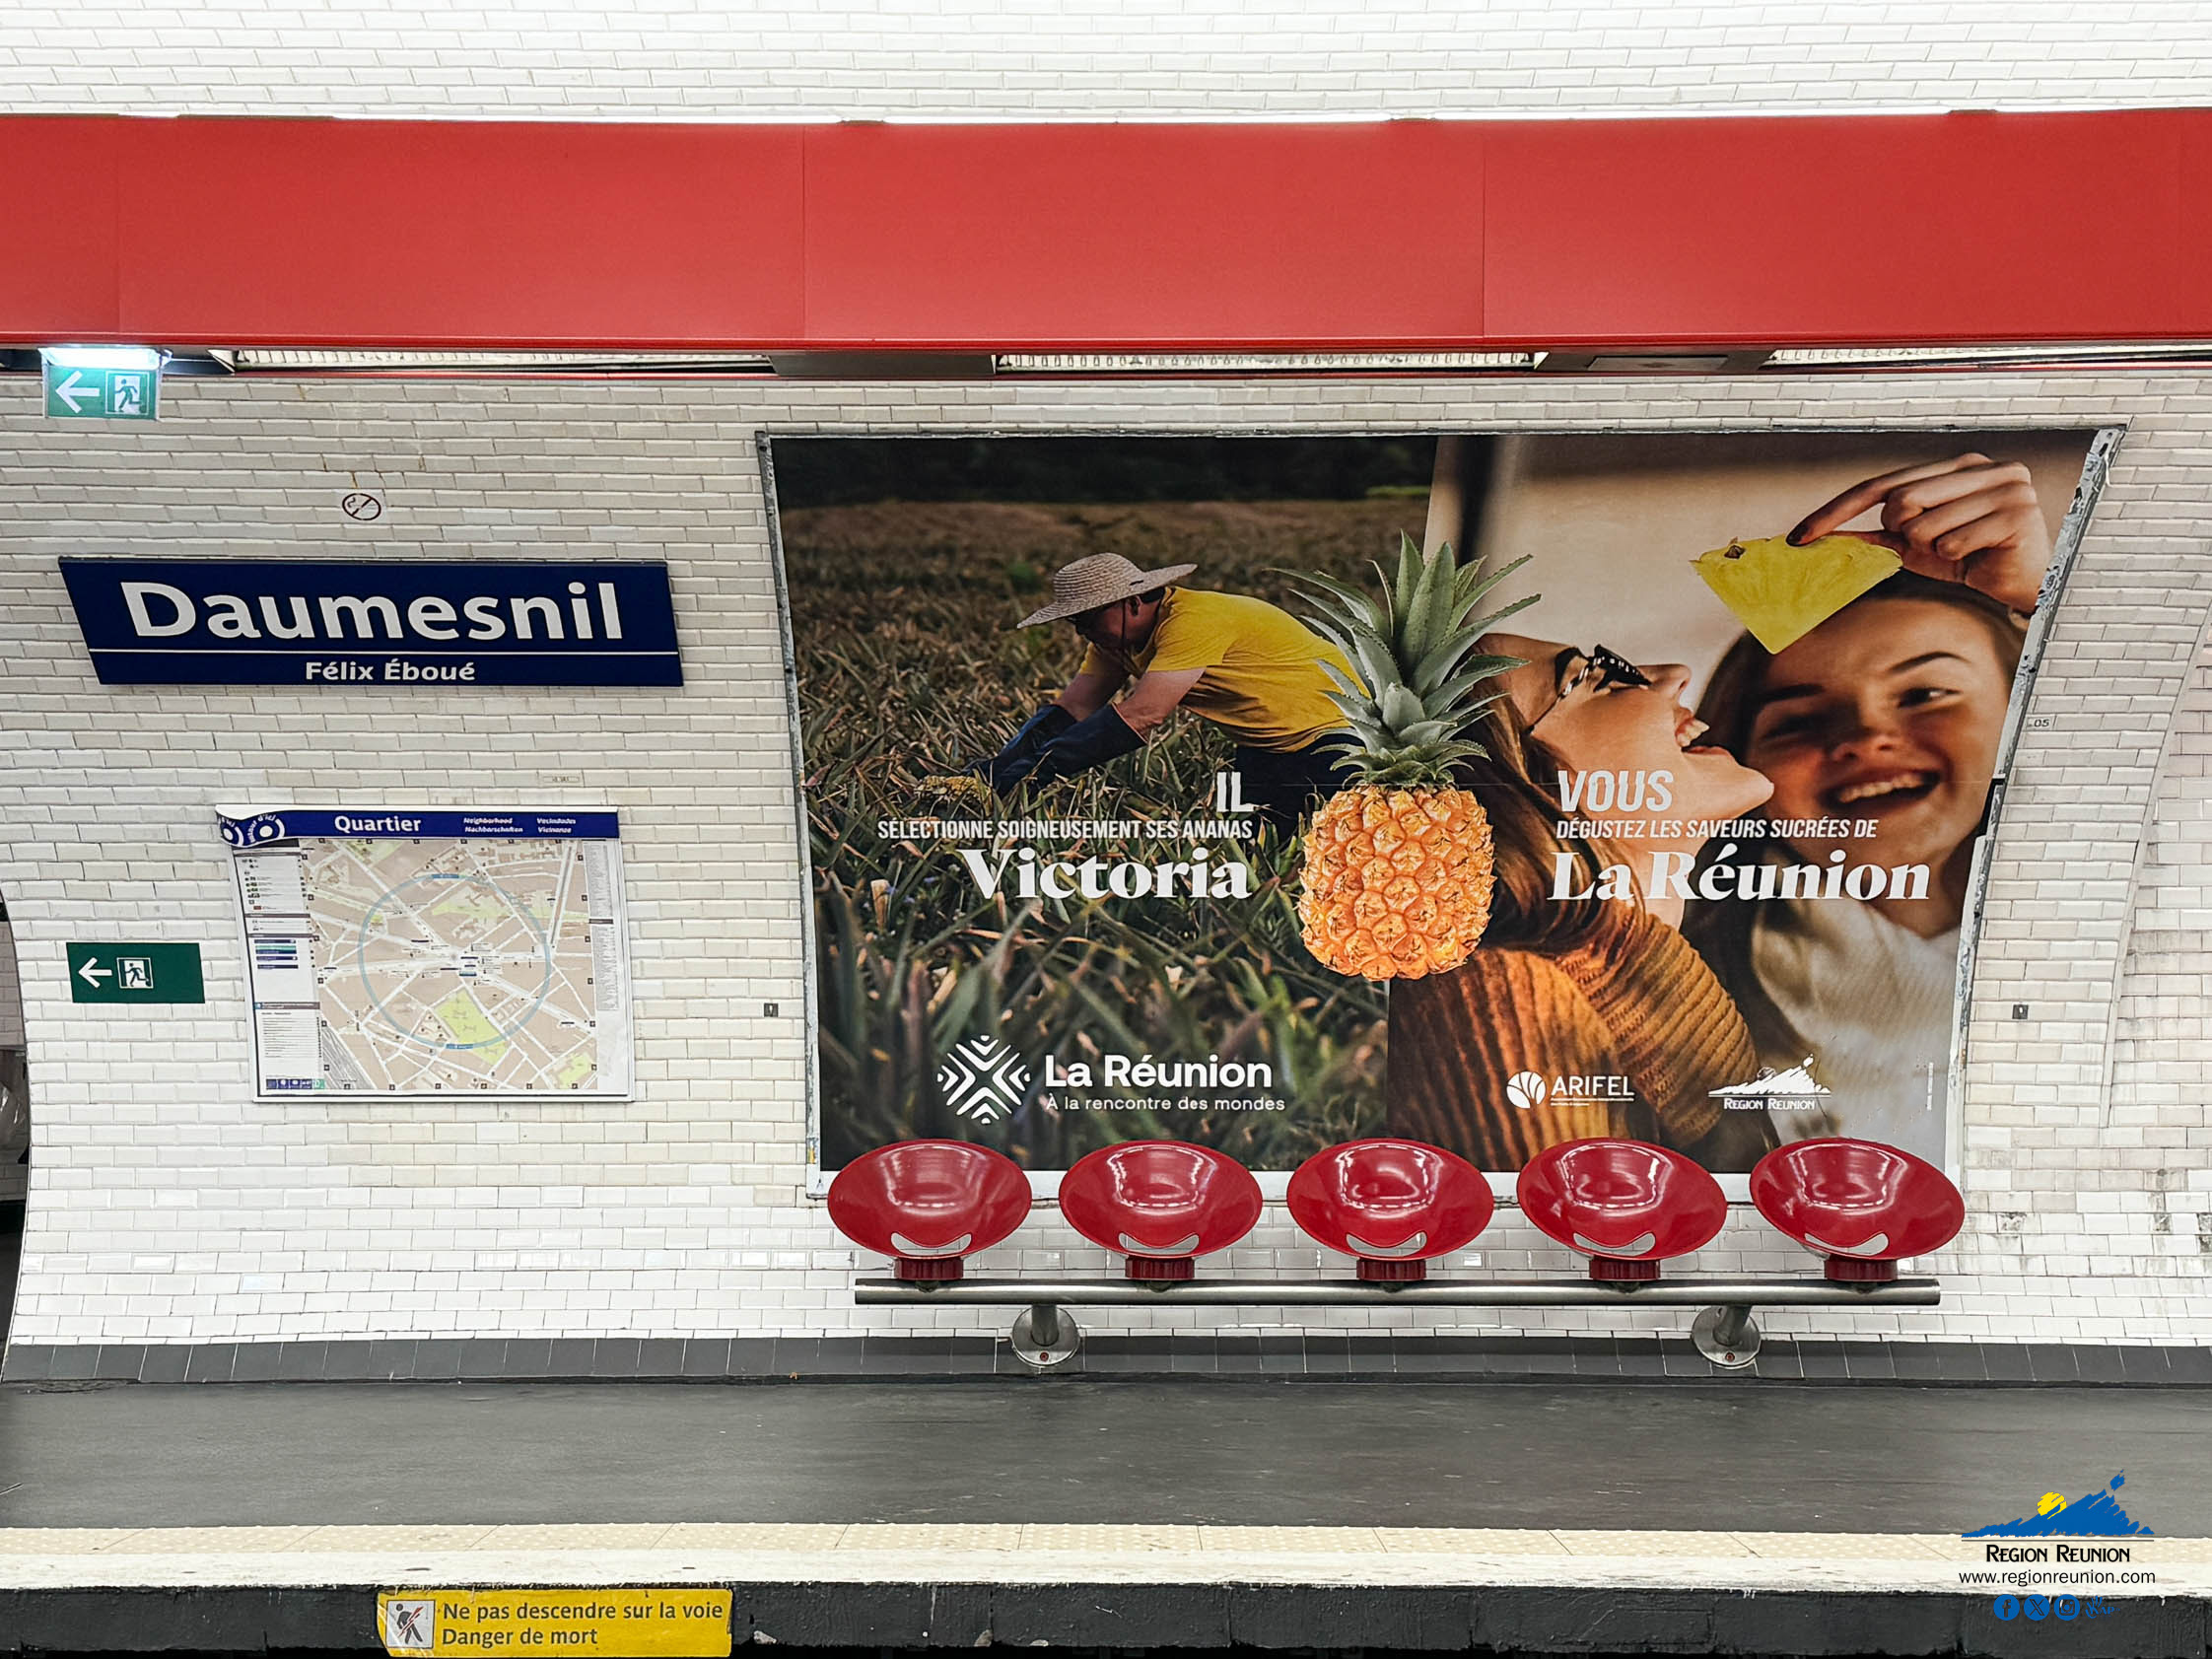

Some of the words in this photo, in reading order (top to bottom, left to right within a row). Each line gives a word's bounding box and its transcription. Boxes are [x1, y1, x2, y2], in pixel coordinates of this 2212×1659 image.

[120, 581, 623, 640] Daumesnil
[305, 661, 375, 681] Félix
[383, 657, 476, 681] Éboué
[1215, 771, 1254, 813] IL
[1556, 770, 1674, 812] VOUS
[334, 815, 421, 834] Quartier
[877, 817, 994, 839] SÉLECTIONNE
[998, 820, 1141, 839] SOIGNEUSEMENT
[1145, 820, 1180, 839] SES
[1182, 820, 1253, 839] ANANAS
[1555, 816, 1646, 839] DÉGUSTEZ
[1649, 820, 1683, 838] LES
[1686, 819, 1767, 838] SAVEURS
[1769, 815, 1850, 838] SUCRÉES
[1853, 819, 1879, 838] DE
[956, 847, 1253, 900] Victoria
[1547, 851, 1634, 901] La
[1646, 843, 1930, 901] Réunion
[1045, 1054, 1093, 1087] La
[1104, 1054, 1273, 1087] Réunion
[1551, 1075, 1635, 1096] ARIFEL
[1046, 1092, 1058, 1110] À
[1065, 1096, 1079, 1110] la
[1085, 1097, 1172, 1110] rencontre
[1178, 1096, 1209, 1110] des
[1214, 1096, 1285, 1111] mondes
[1723, 1097, 1763, 1110] REGION
[443, 1603, 470, 1620] Ne
[477, 1605, 510, 1623] pas
[517, 1602, 616, 1619] descendre
[623, 1604, 654, 1619] sur
[659, 1602, 676, 1619] la
[683, 1602, 724, 1619] voie
[443, 1628, 514, 1648] Danger
[519, 1627, 544, 1644] de
[550, 1628, 598, 1644] mort
